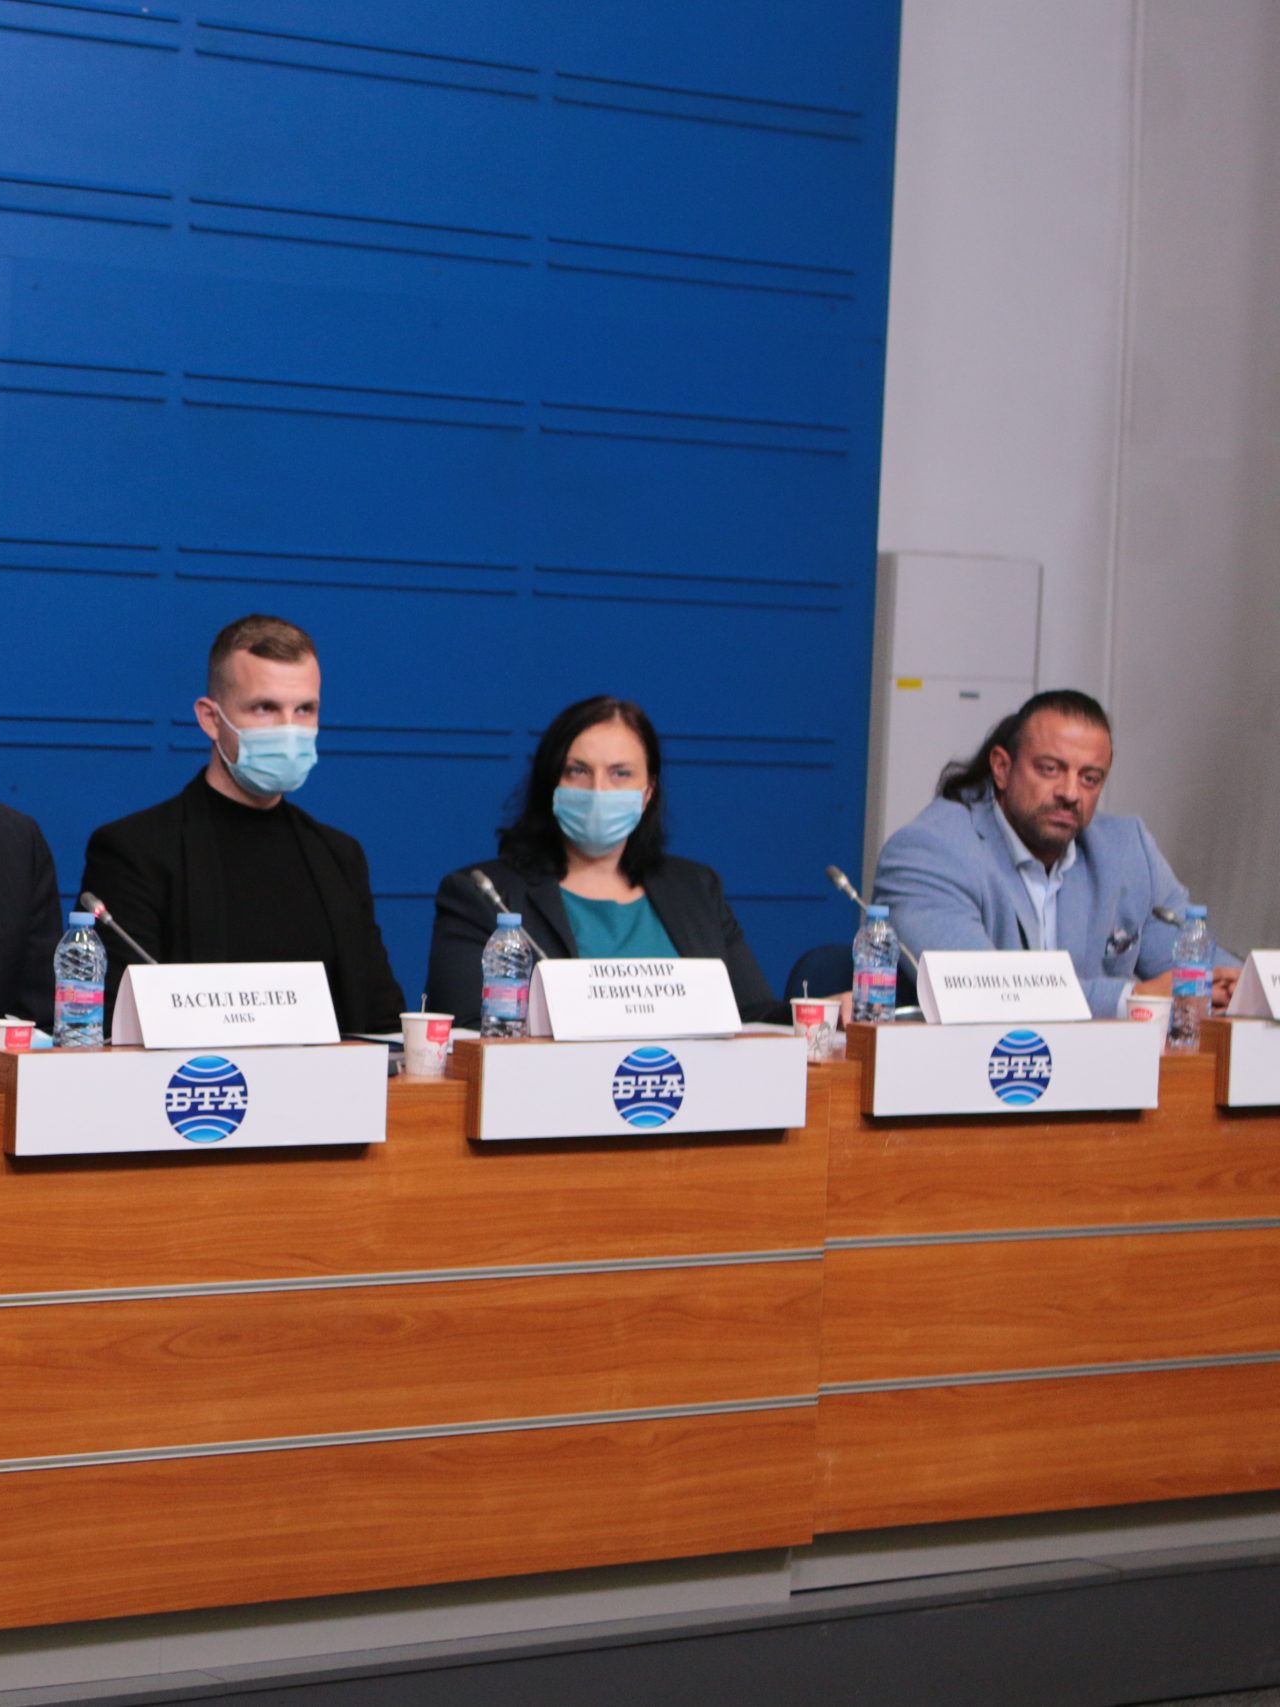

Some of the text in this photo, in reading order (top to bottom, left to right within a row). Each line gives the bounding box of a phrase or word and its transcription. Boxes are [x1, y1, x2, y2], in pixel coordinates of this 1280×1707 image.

[588, 963, 675, 978] ЛЮБОМИР
[171, 990, 297, 1008] ВАСИЛ ВЕЛЕВ
[587, 983, 686, 999] ЛЕВИЧАРОВ
[990, 1055, 1051, 1079] БТА
[613, 1074, 685, 1099] БТА
[166, 1085, 248, 1112] БТА
